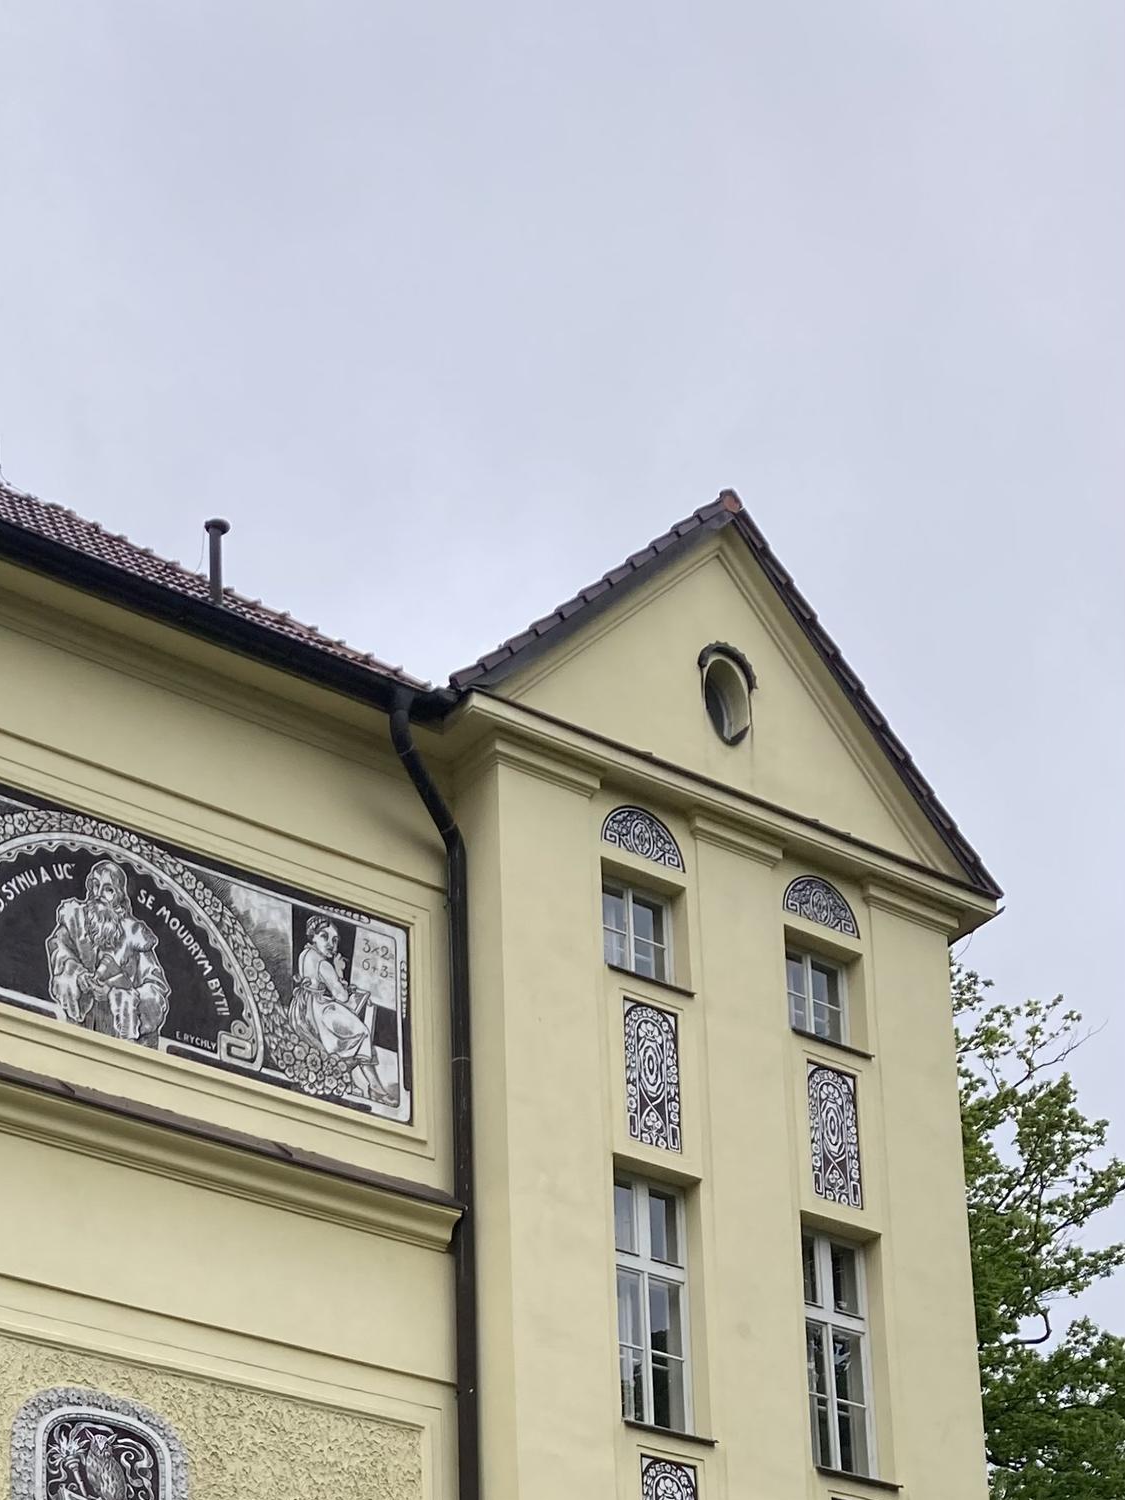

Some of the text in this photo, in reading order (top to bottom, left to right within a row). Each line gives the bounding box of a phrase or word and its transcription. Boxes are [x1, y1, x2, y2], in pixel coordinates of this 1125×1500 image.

[1, 869, 38, 900] SYNU
[40, 865, 52, 883] A
[137, 889, 156, 910] SE
